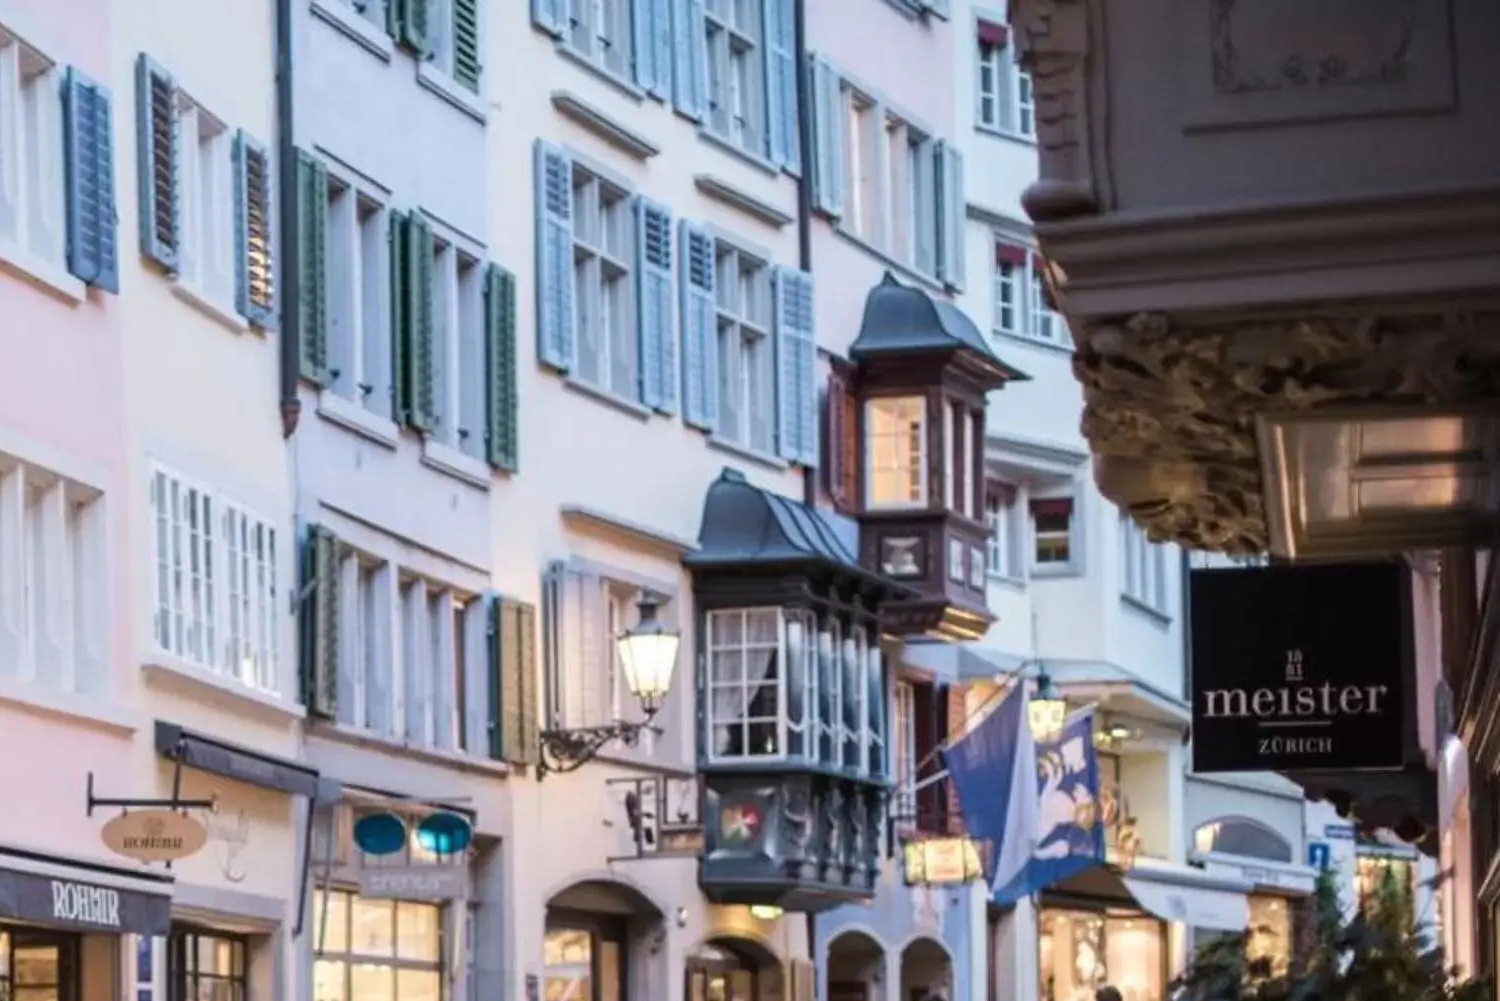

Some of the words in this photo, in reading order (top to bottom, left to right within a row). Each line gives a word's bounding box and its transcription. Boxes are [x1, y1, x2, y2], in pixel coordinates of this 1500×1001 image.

[1203, 680, 1388, 718] meister
[1258, 737, 1333, 755] ZÜRICH
[51, 879, 120, 927] ROHMIR
